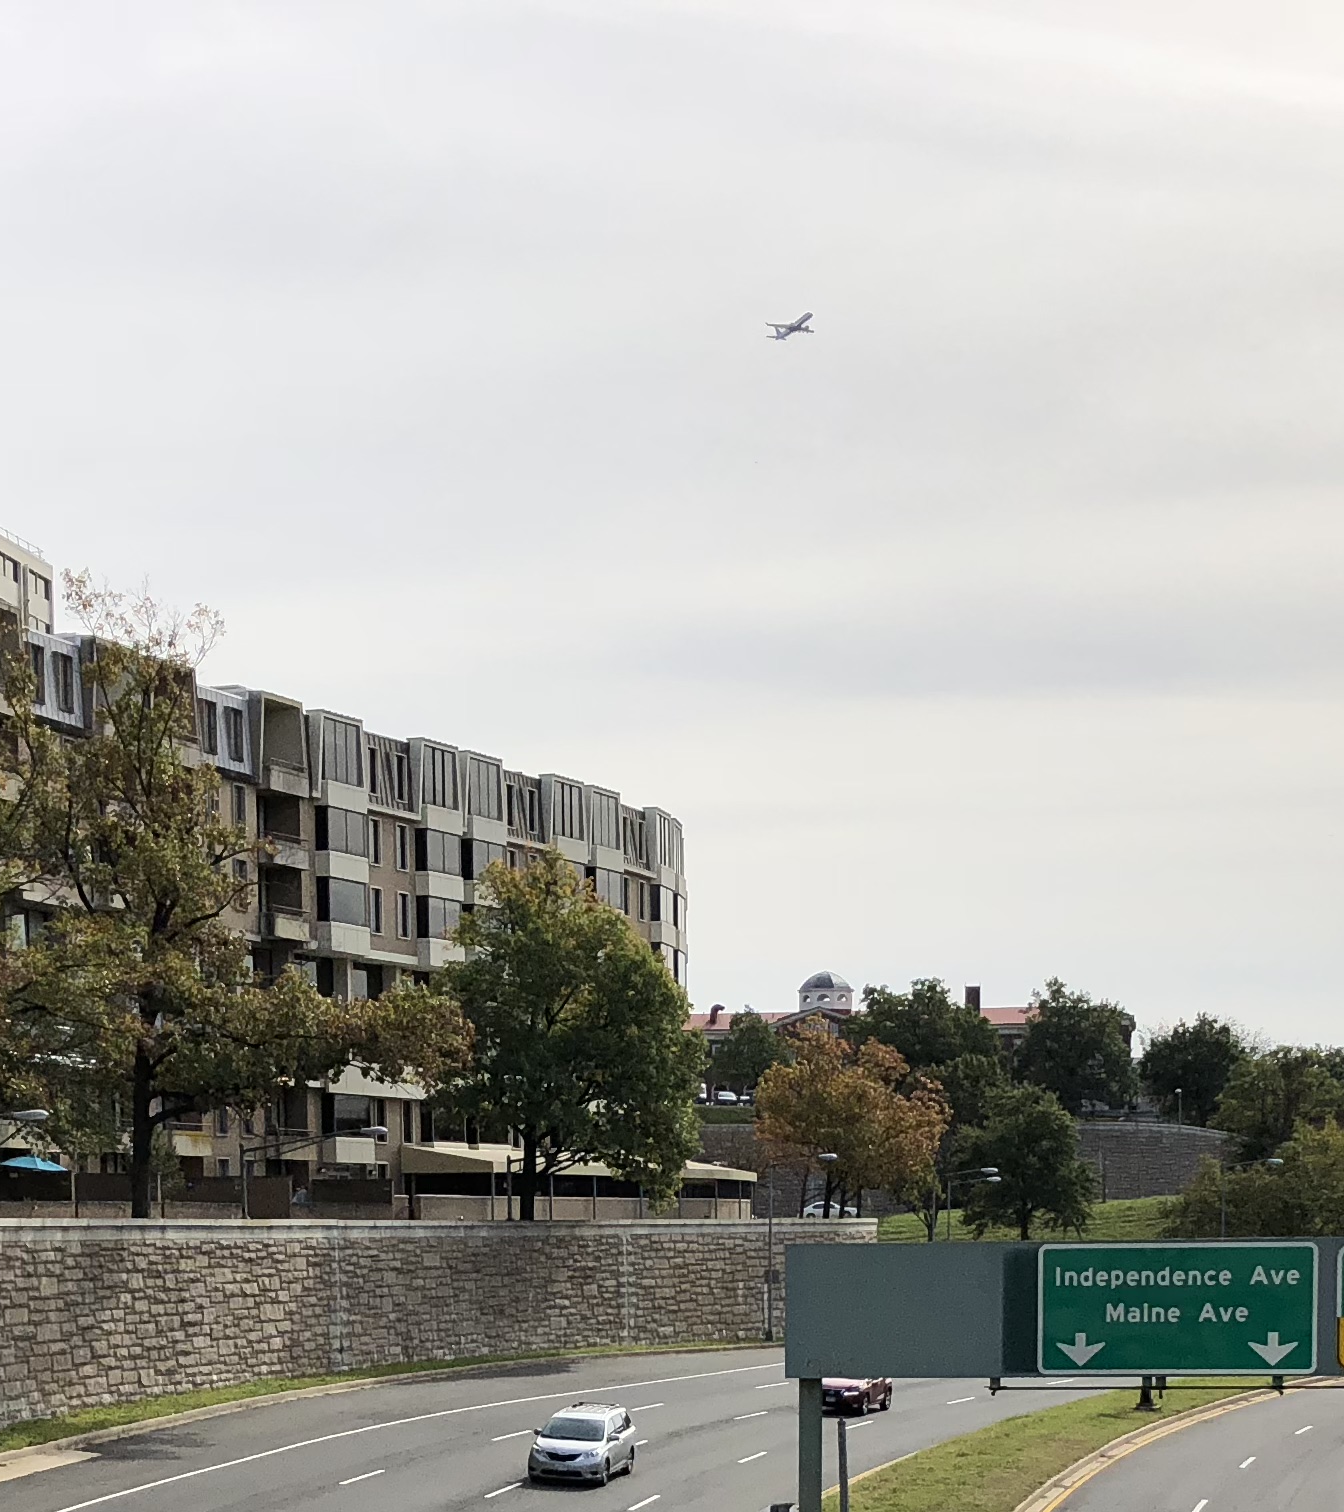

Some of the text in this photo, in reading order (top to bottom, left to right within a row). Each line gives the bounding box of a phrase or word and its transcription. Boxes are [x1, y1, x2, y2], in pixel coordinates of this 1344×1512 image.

[1055, 1265, 1301, 1290] Independence Ave
[1105, 1302, 1249, 1324] Maine Ave
